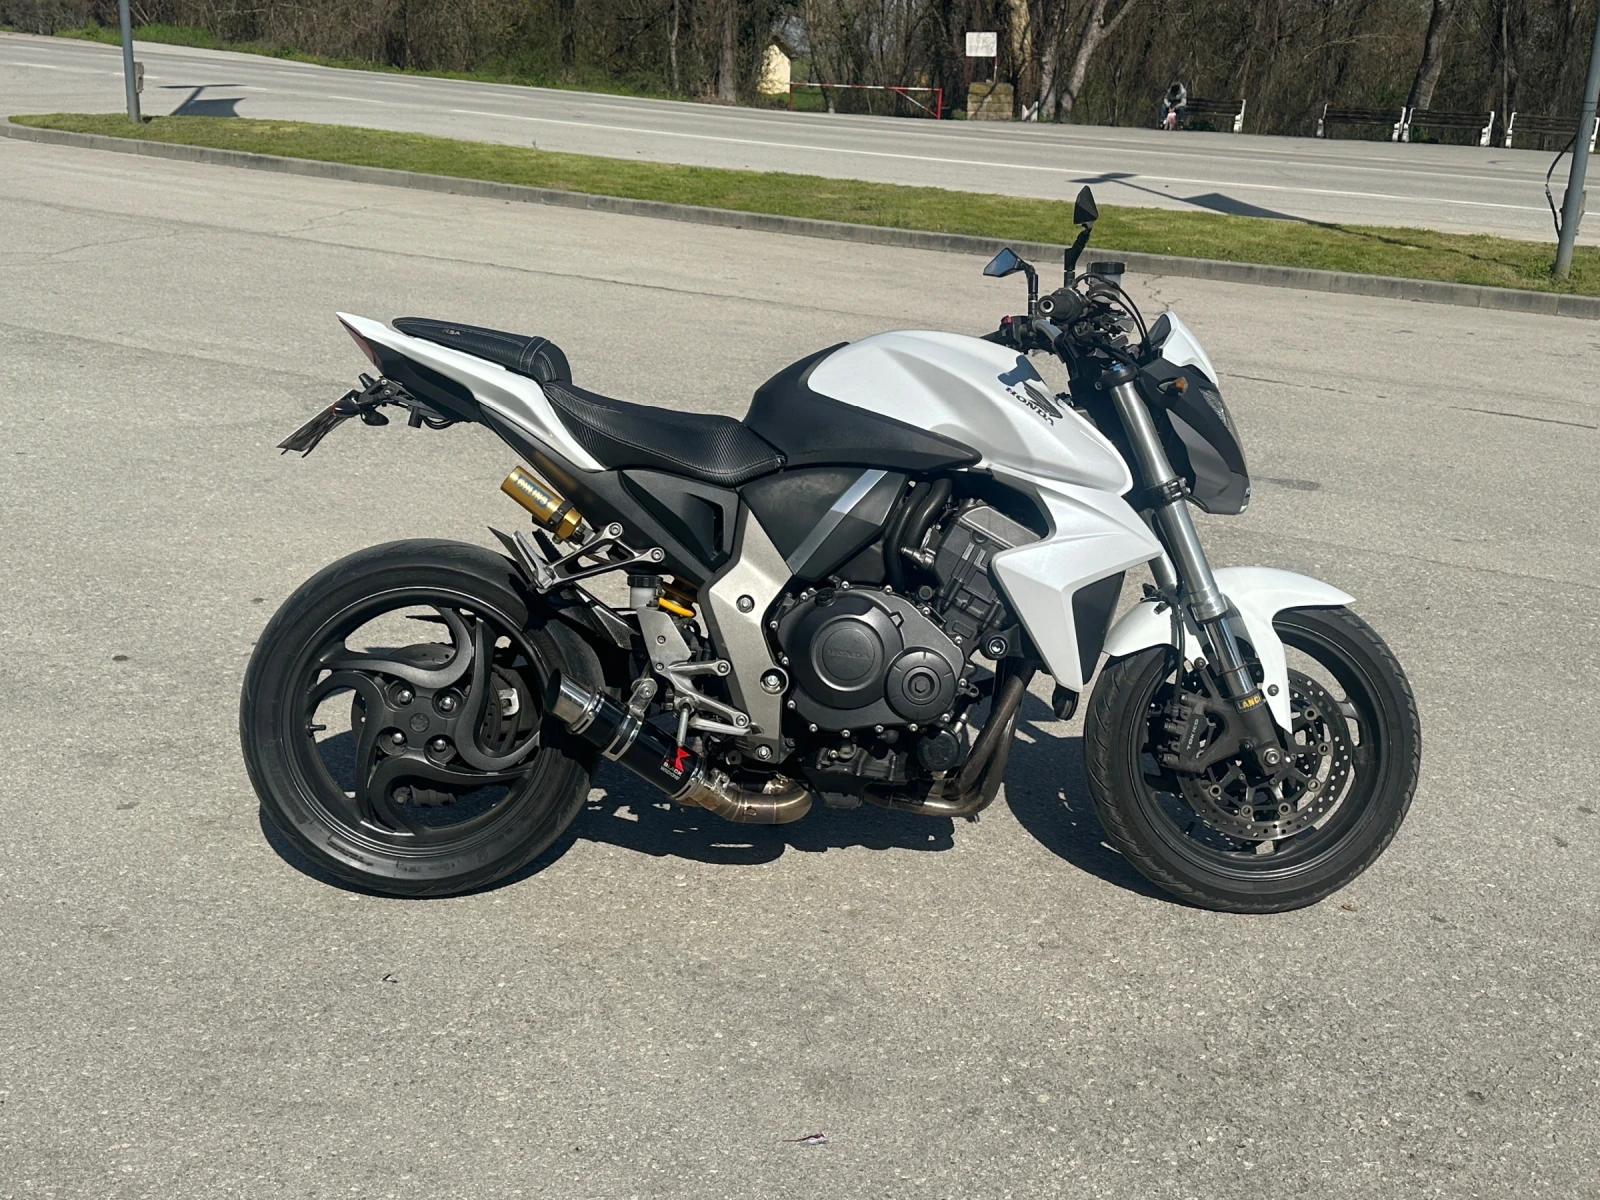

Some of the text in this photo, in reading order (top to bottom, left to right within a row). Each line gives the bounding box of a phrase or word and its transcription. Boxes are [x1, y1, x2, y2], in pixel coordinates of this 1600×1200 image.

[1005, 386, 1055, 427] HONDA
[827, 648, 870, 660] HONDA
[660, 765, 681, 781] WIDOW
[663, 761, 683, 777] BLACK
